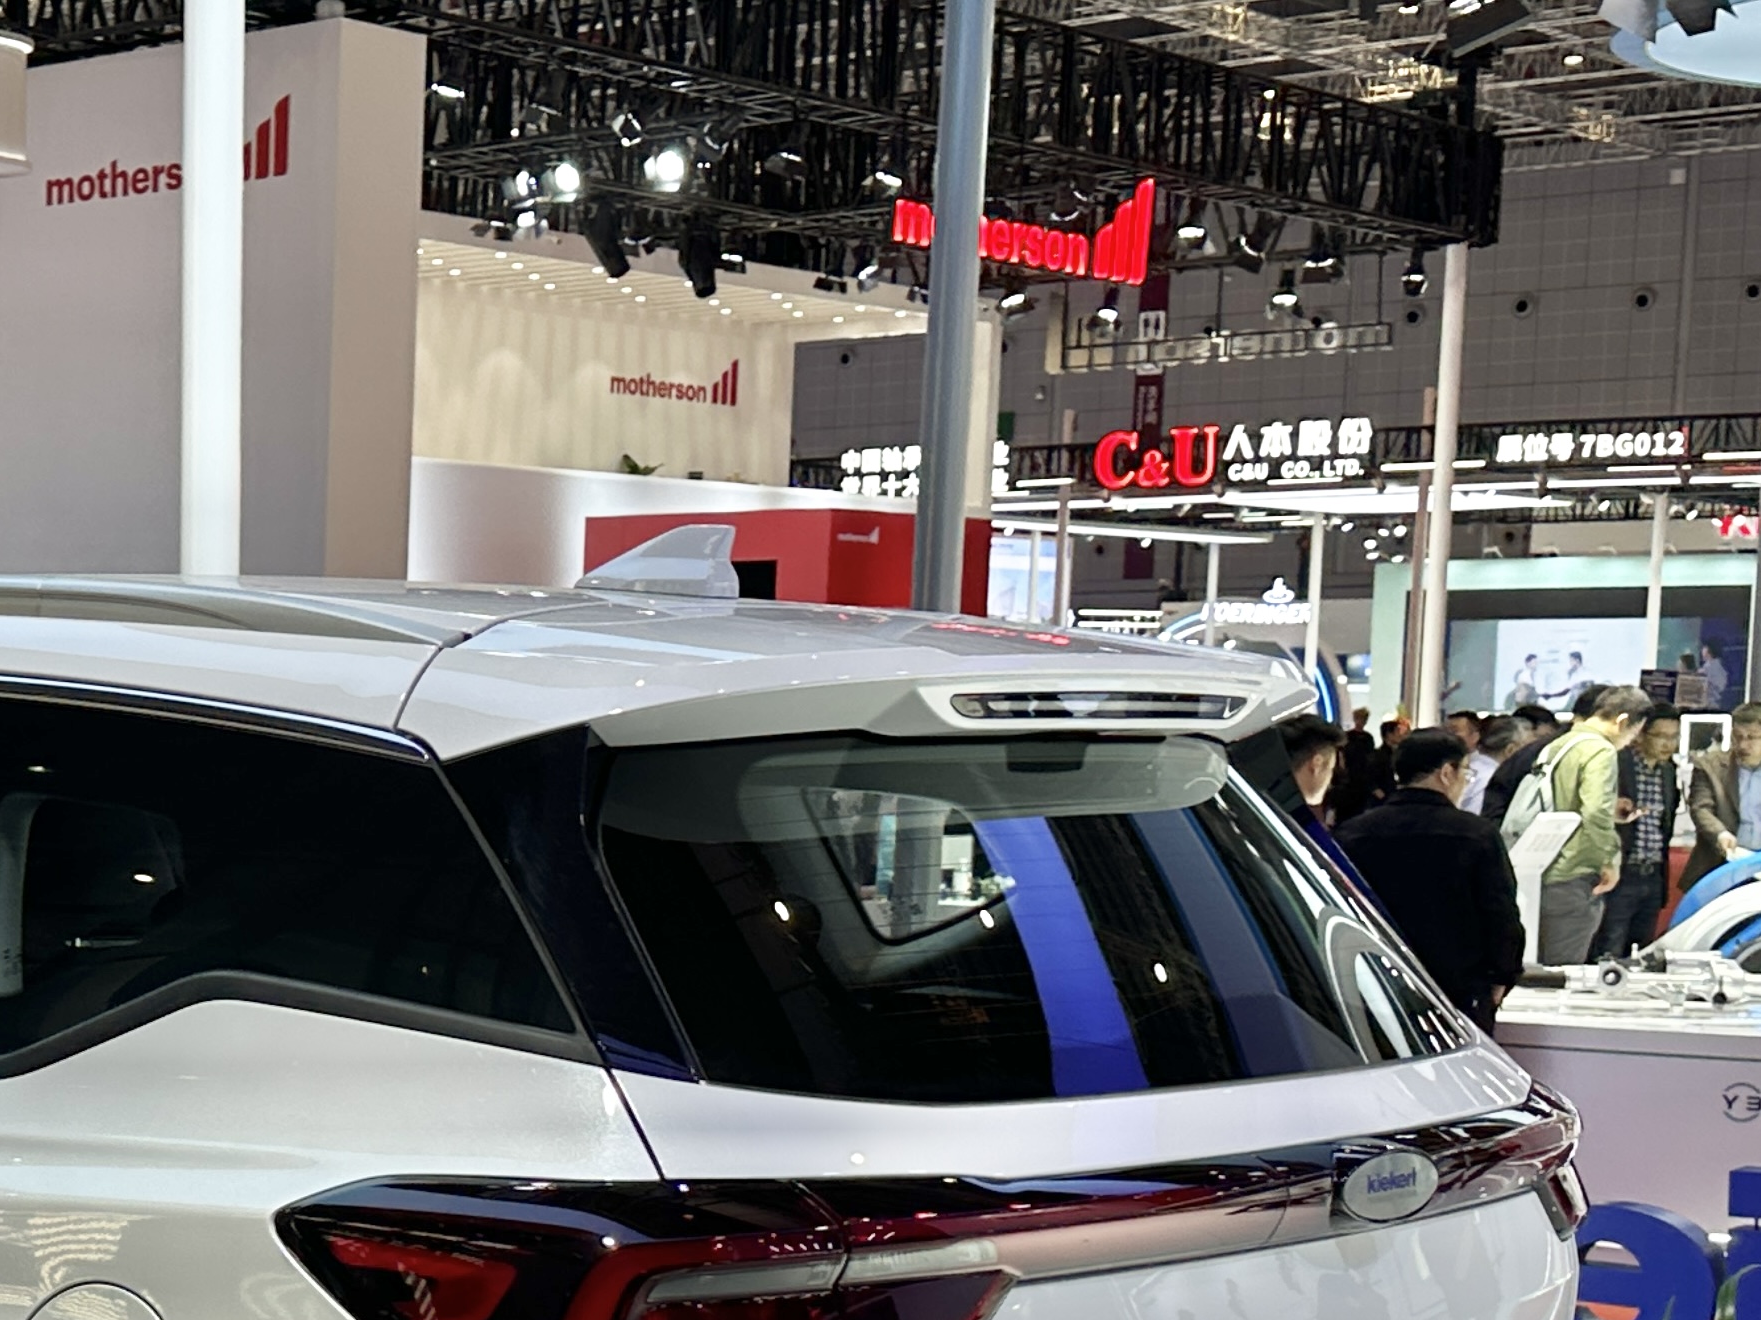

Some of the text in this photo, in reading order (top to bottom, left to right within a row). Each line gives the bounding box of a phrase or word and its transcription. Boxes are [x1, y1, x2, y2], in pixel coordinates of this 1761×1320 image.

[45, 160, 182, 206] mothers
[610, 372, 707, 403] motherson
[1222, 417, 1373, 460] 人本股份
[1579, 430, 1685, 458] 7BG012
[1093, 424, 1221, 490] C&U
[1228, 462, 1269, 481] C&U
[1367, 1167, 1417, 1195] kiekert
